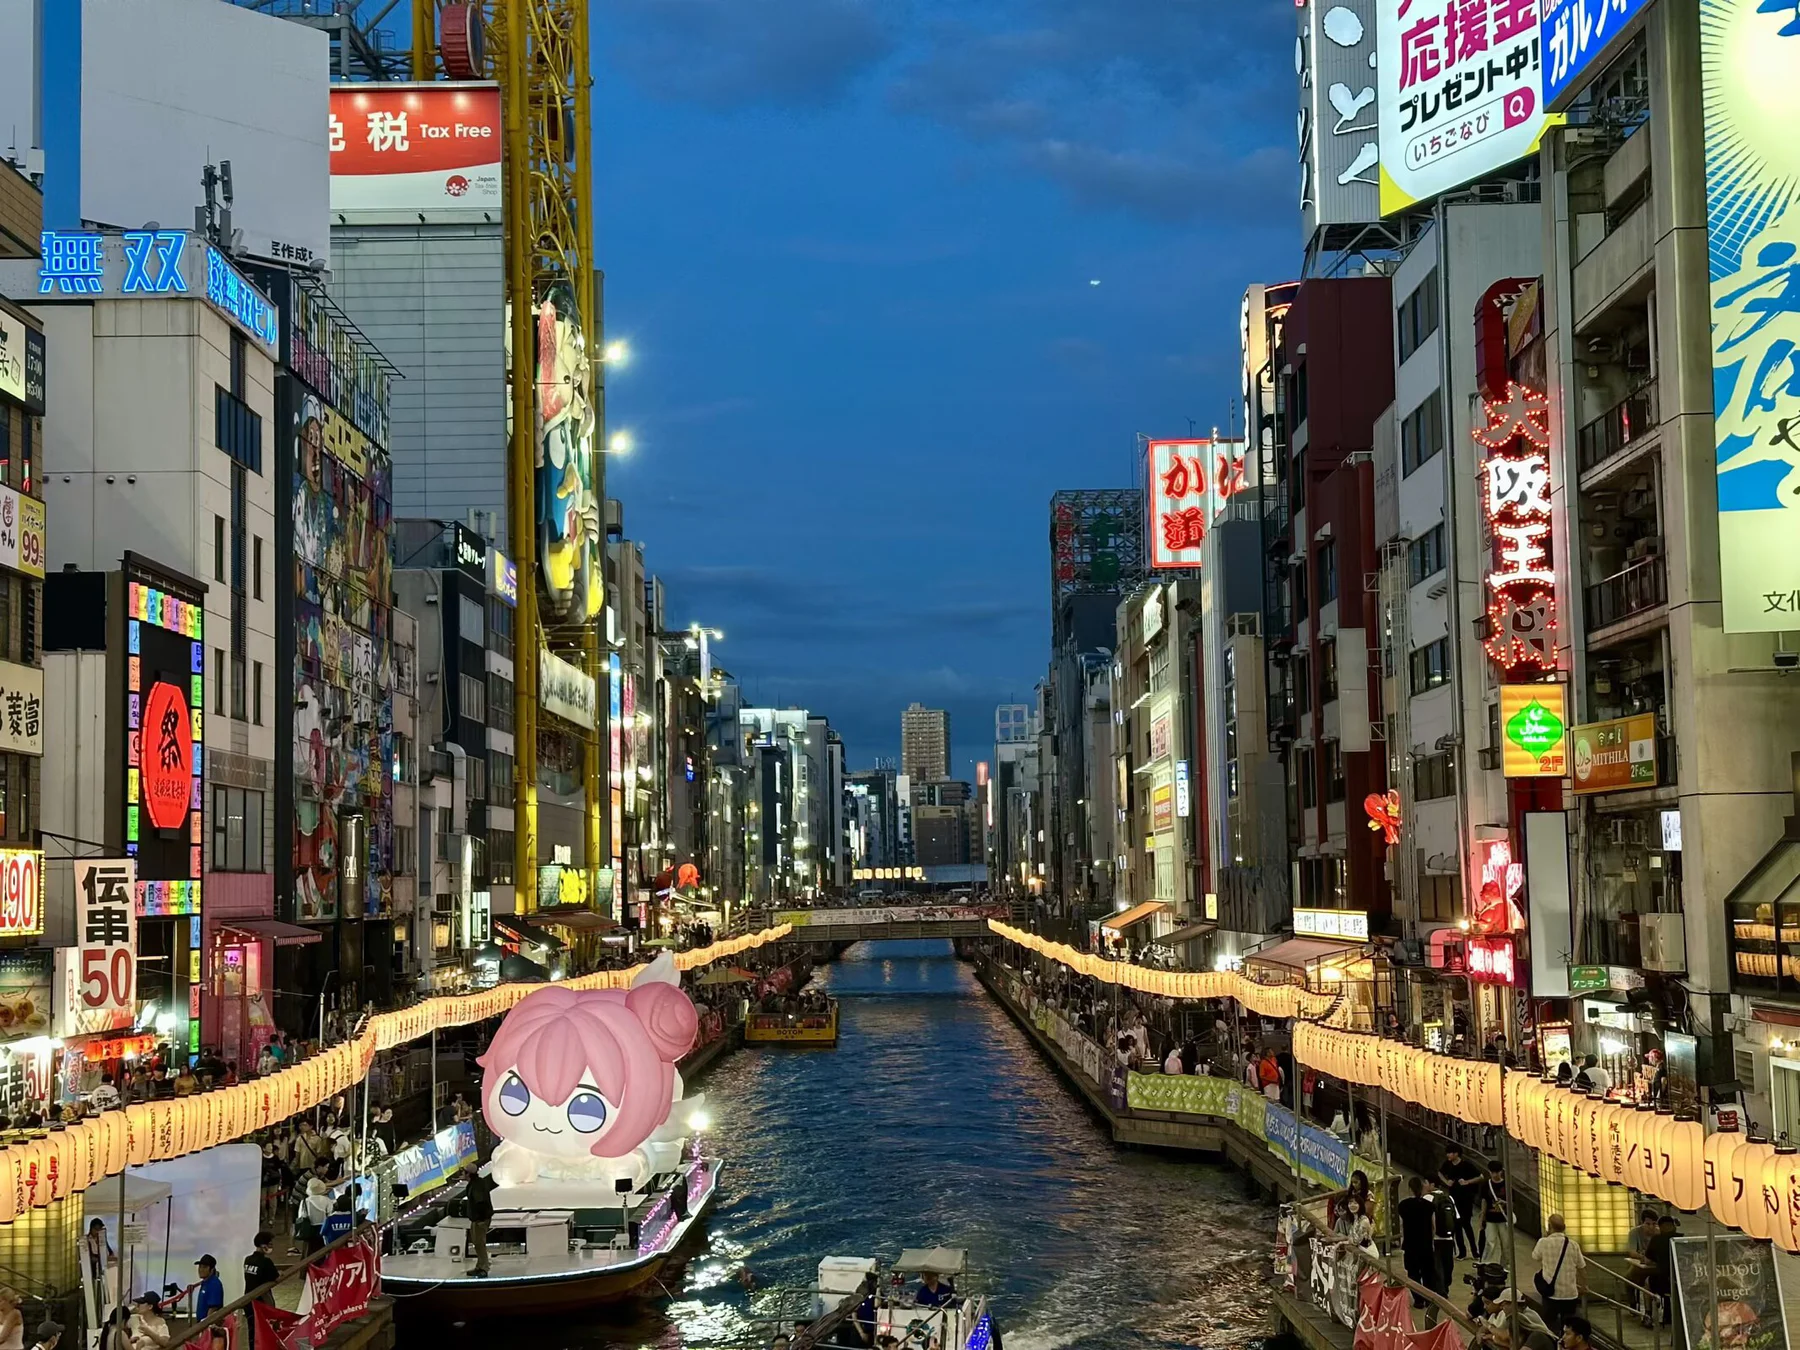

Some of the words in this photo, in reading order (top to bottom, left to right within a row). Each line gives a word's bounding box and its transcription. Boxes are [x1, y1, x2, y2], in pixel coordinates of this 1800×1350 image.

[420, 124, 449, 138] Tax
[455, 124, 492, 137] Free
[1414, 112, 1490, 163] いちごなび
[39, 231, 188, 293] 無双
[27, 354, 42, 376] 17:00
[1473, 381, 1558, 670] 大阪王将
[22, 530, 40, 567] 99
[1540, 756, 1564, 772] 2F
[1592, 750, 1629, 767] MITHILA
[1630, 765, 1639, 778] 2F
[82, 866, 130, 946] 伝串
[82, 948, 132, 1007] 50
